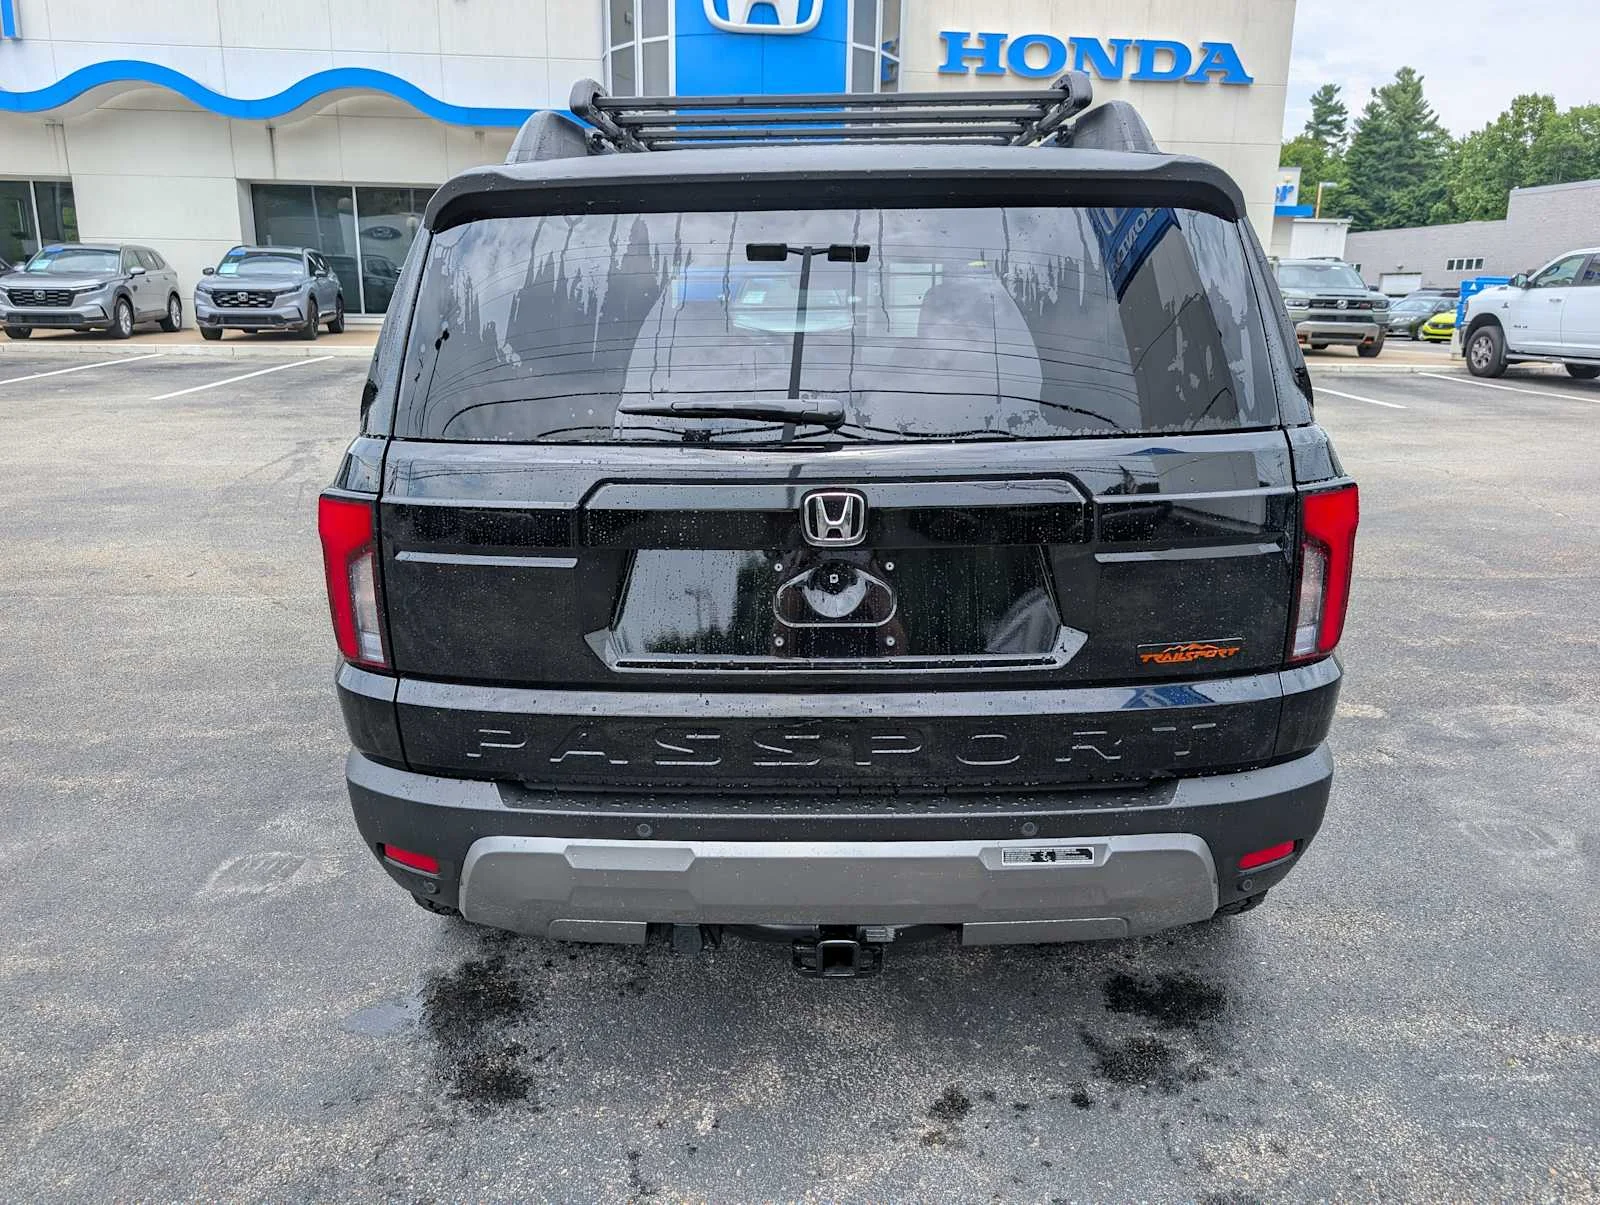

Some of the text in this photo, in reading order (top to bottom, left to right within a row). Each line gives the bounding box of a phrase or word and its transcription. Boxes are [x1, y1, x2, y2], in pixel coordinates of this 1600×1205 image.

[938, 31, 1254, 84] HONDA
[1140, 646, 1241, 664] TRAILSPORT
[465, 716, 1222, 767] PASSPORT
